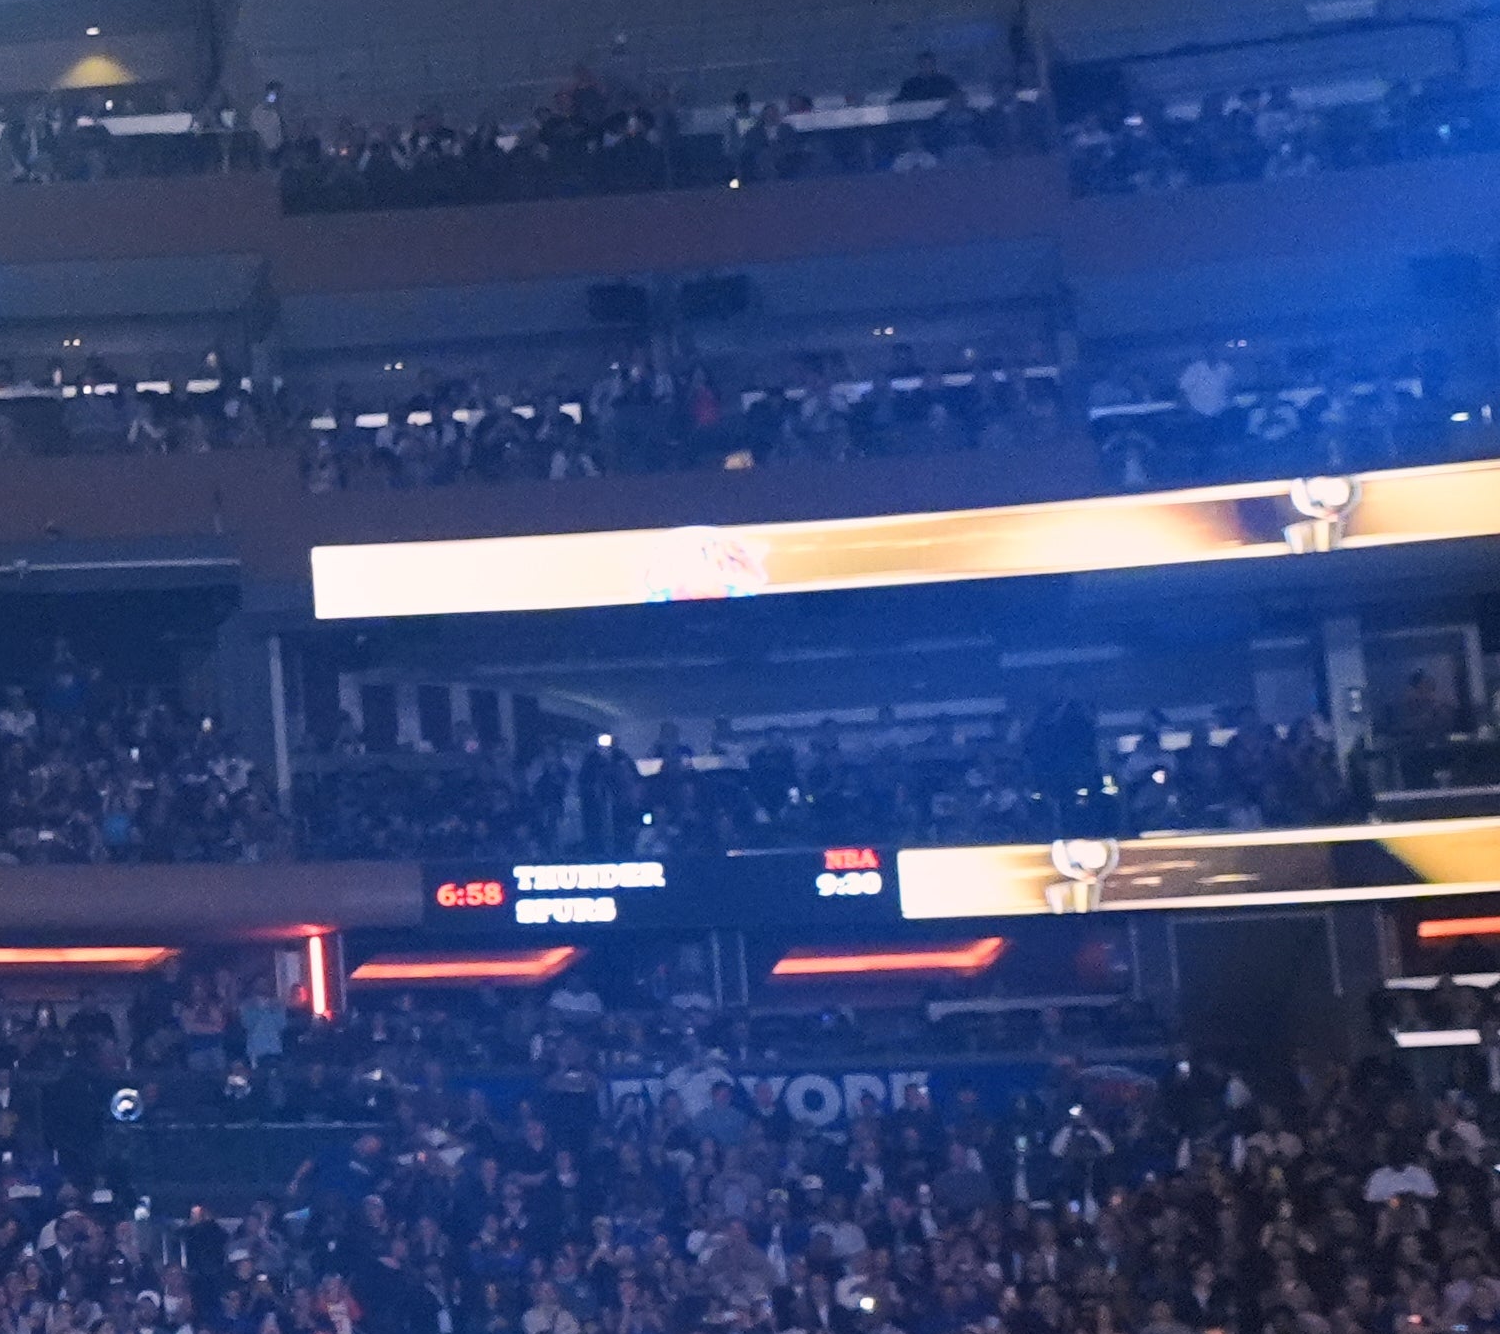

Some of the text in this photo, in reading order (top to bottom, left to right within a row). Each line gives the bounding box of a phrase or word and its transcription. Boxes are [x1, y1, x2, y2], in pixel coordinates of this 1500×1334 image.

[823, 848, 880, 870] NBA
[512, 863, 667, 890] THUNDER
[436, 881, 504, 907] 6:58
[515, 897, 617, 924] SPURS
